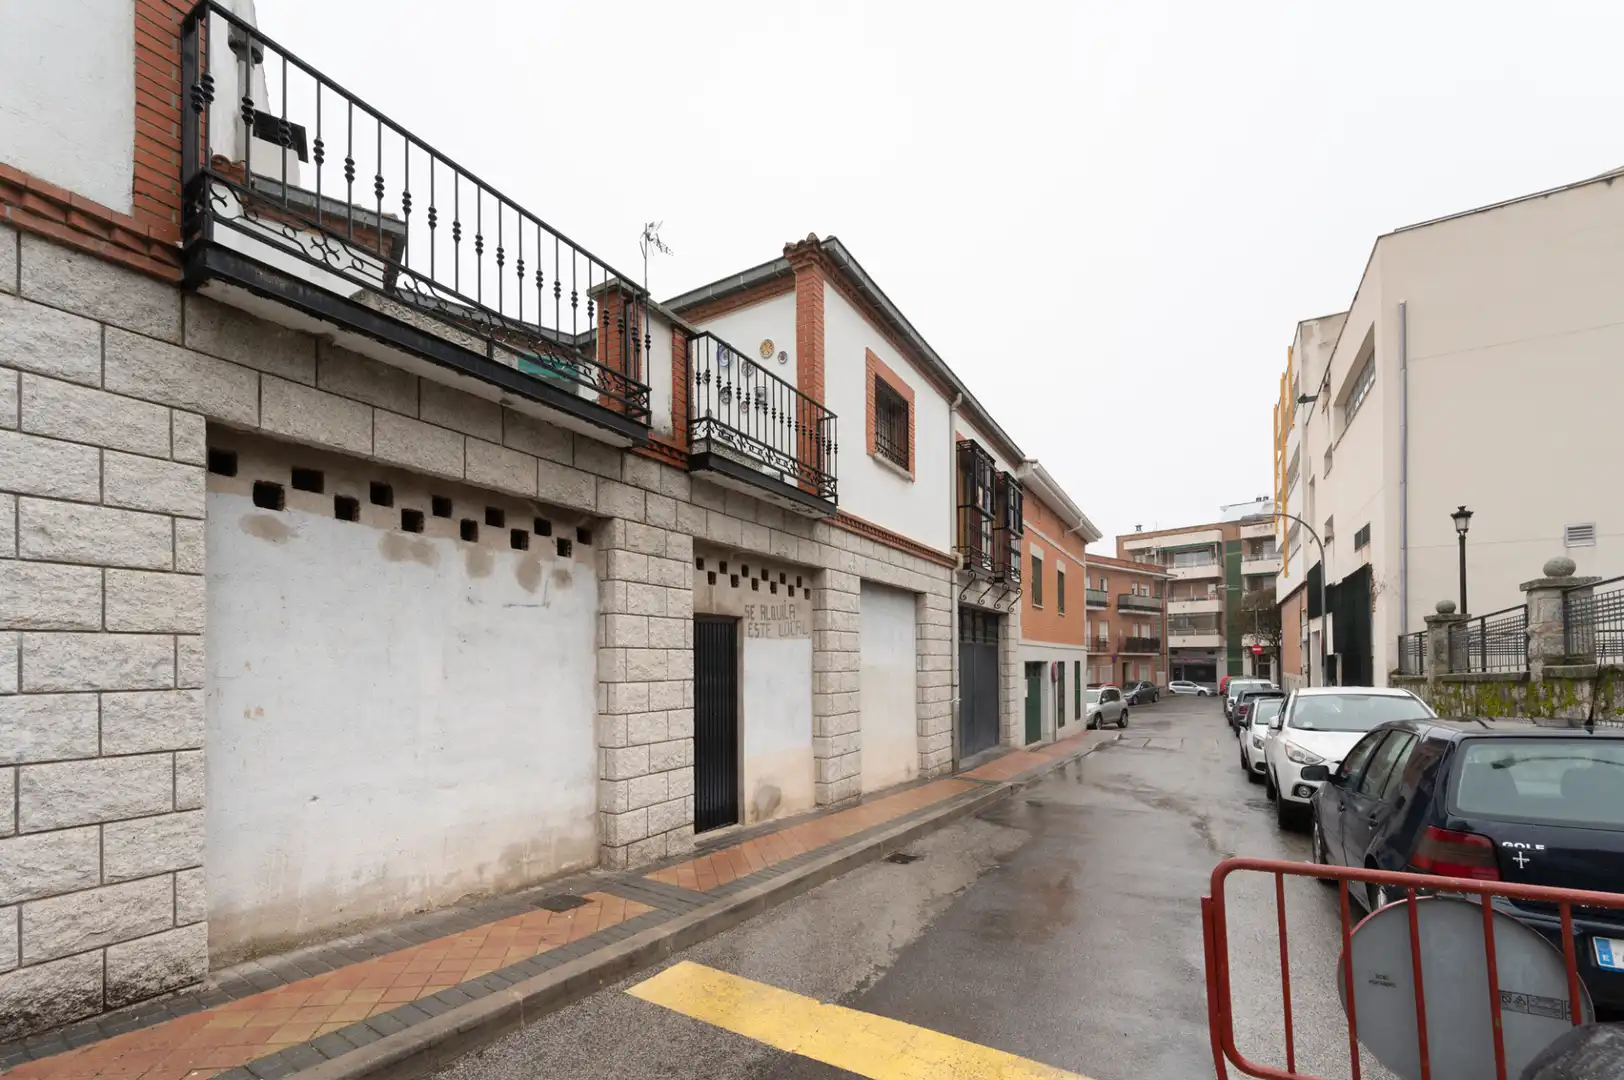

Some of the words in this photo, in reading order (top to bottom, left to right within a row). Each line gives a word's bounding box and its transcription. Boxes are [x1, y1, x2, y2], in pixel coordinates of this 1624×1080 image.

[744, 604, 756, 620] SE
[760, 603, 796, 621] ALQUILA
[747, 622, 773, 638] ESTE
[778, 620, 809, 637] LOCAL
